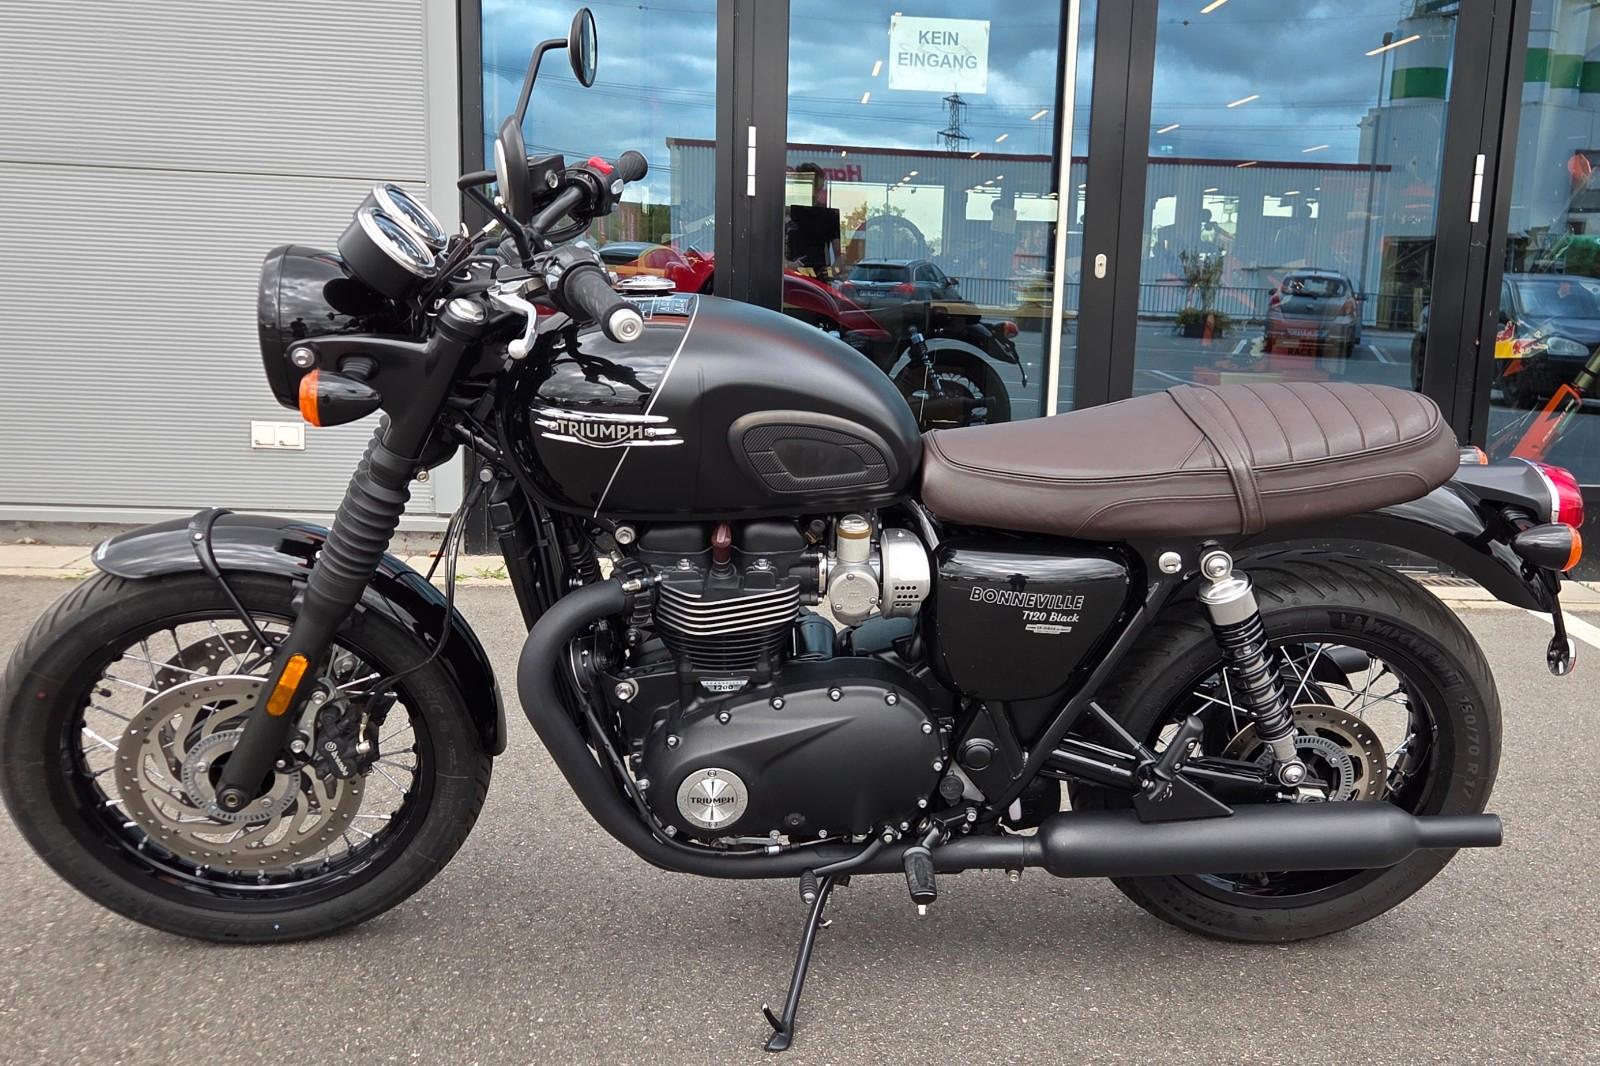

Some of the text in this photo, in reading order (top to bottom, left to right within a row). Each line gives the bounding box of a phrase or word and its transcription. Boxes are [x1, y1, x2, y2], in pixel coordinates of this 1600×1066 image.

[918, 30, 959, 46] KEIN
[897, 52, 978, 69] EINGANG
[557, 419, 643, 441] TRIUMPH
[970, 586, 1085, 610] BONNEVILLE
[1022, 610, 1080, 623] T120 Black
[690, 796, 735, 805] TRIUMPH
